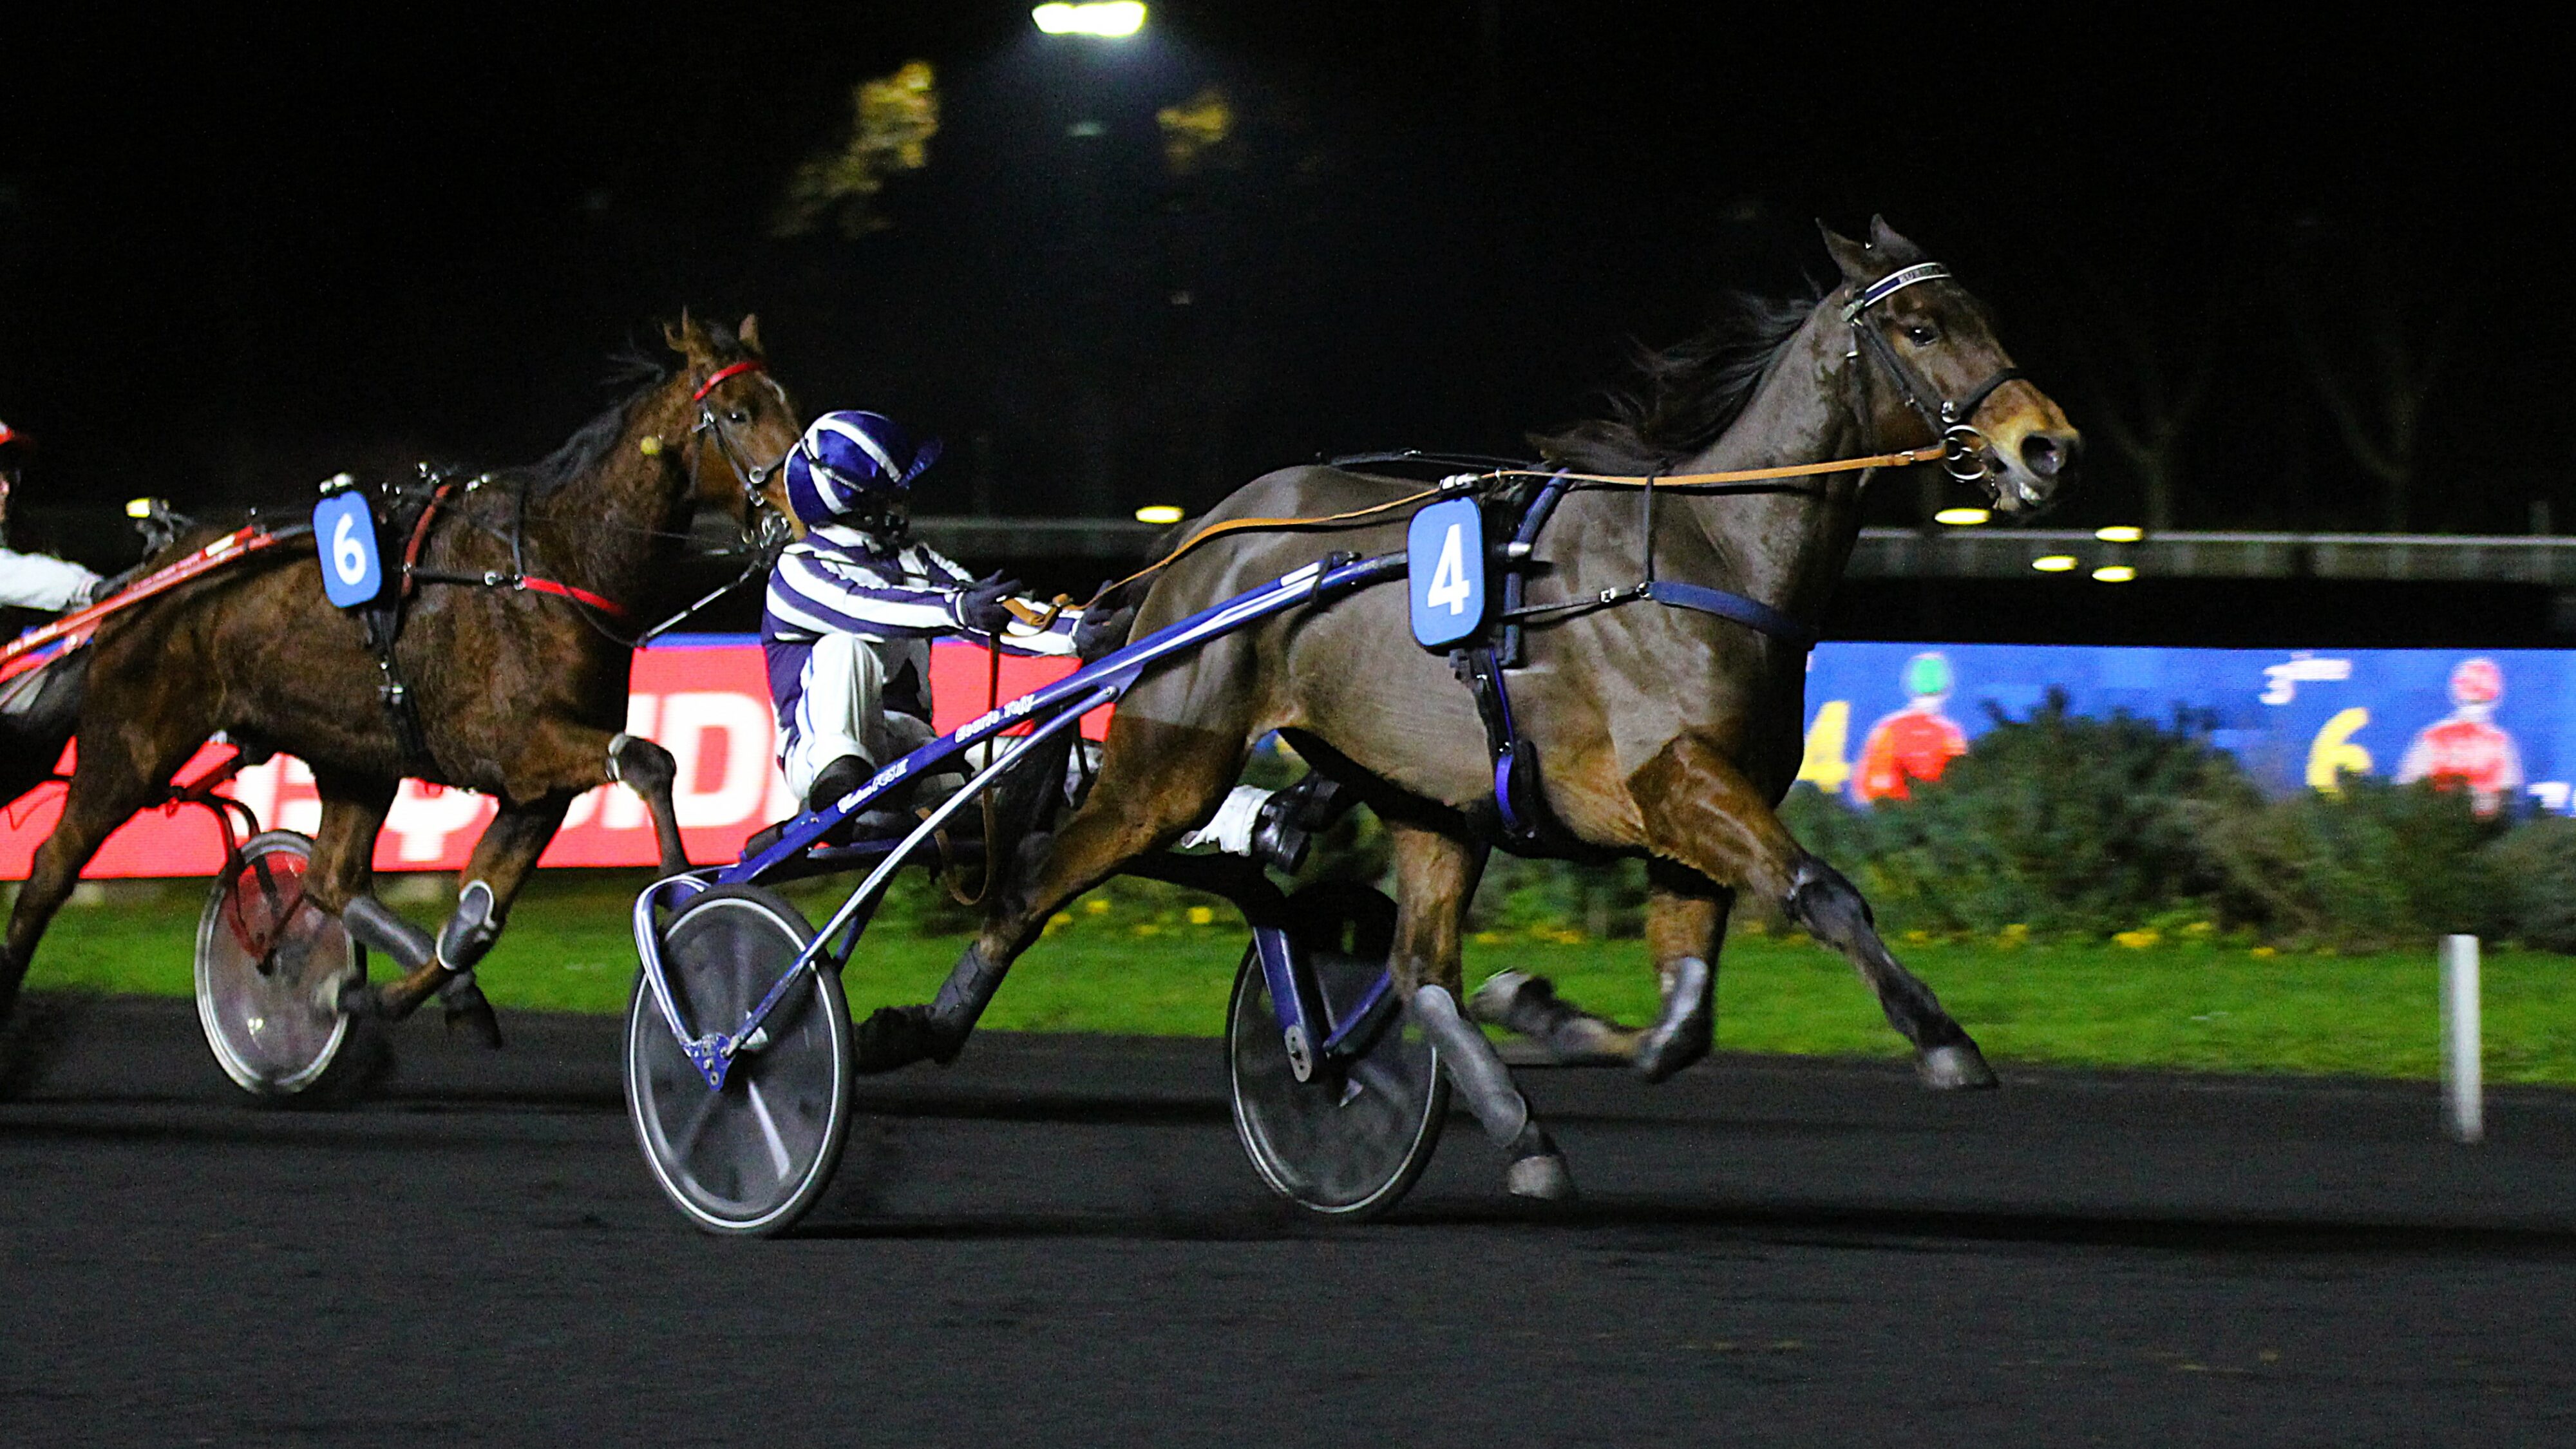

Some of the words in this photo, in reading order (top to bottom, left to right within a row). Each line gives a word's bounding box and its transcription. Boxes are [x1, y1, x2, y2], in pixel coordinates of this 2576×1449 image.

[333, 513, 366, 585] 6
[1428, 524, 1470, 616] 4
[2306, 706, 2374, 793] 6
